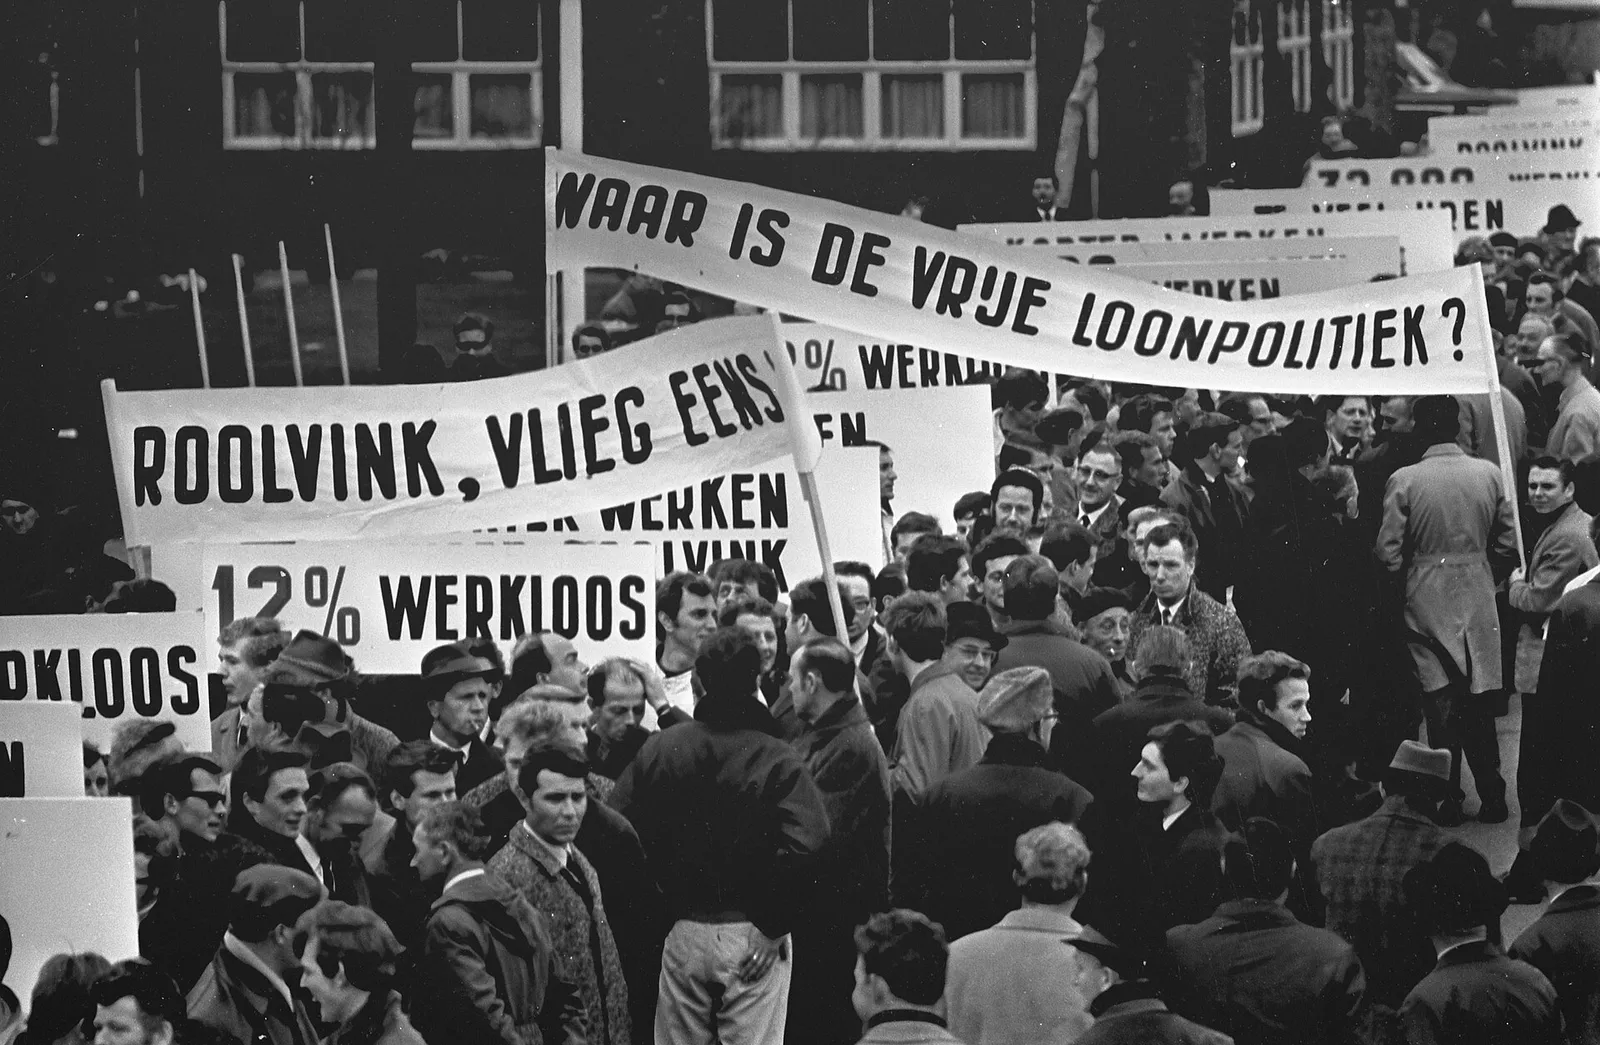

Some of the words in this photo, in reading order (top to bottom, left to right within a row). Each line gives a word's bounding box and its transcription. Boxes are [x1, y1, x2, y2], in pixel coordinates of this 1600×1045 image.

[556, 171, 708, 248] WAAR
[728, 202, 791, 268] IS
[811, 222, 892, 298] DE
[911, 245, 1052, 336] VRIJE
[485, 386, 653, 489] VLIEG
[379, 574, 646, 642] WERKLOOS
